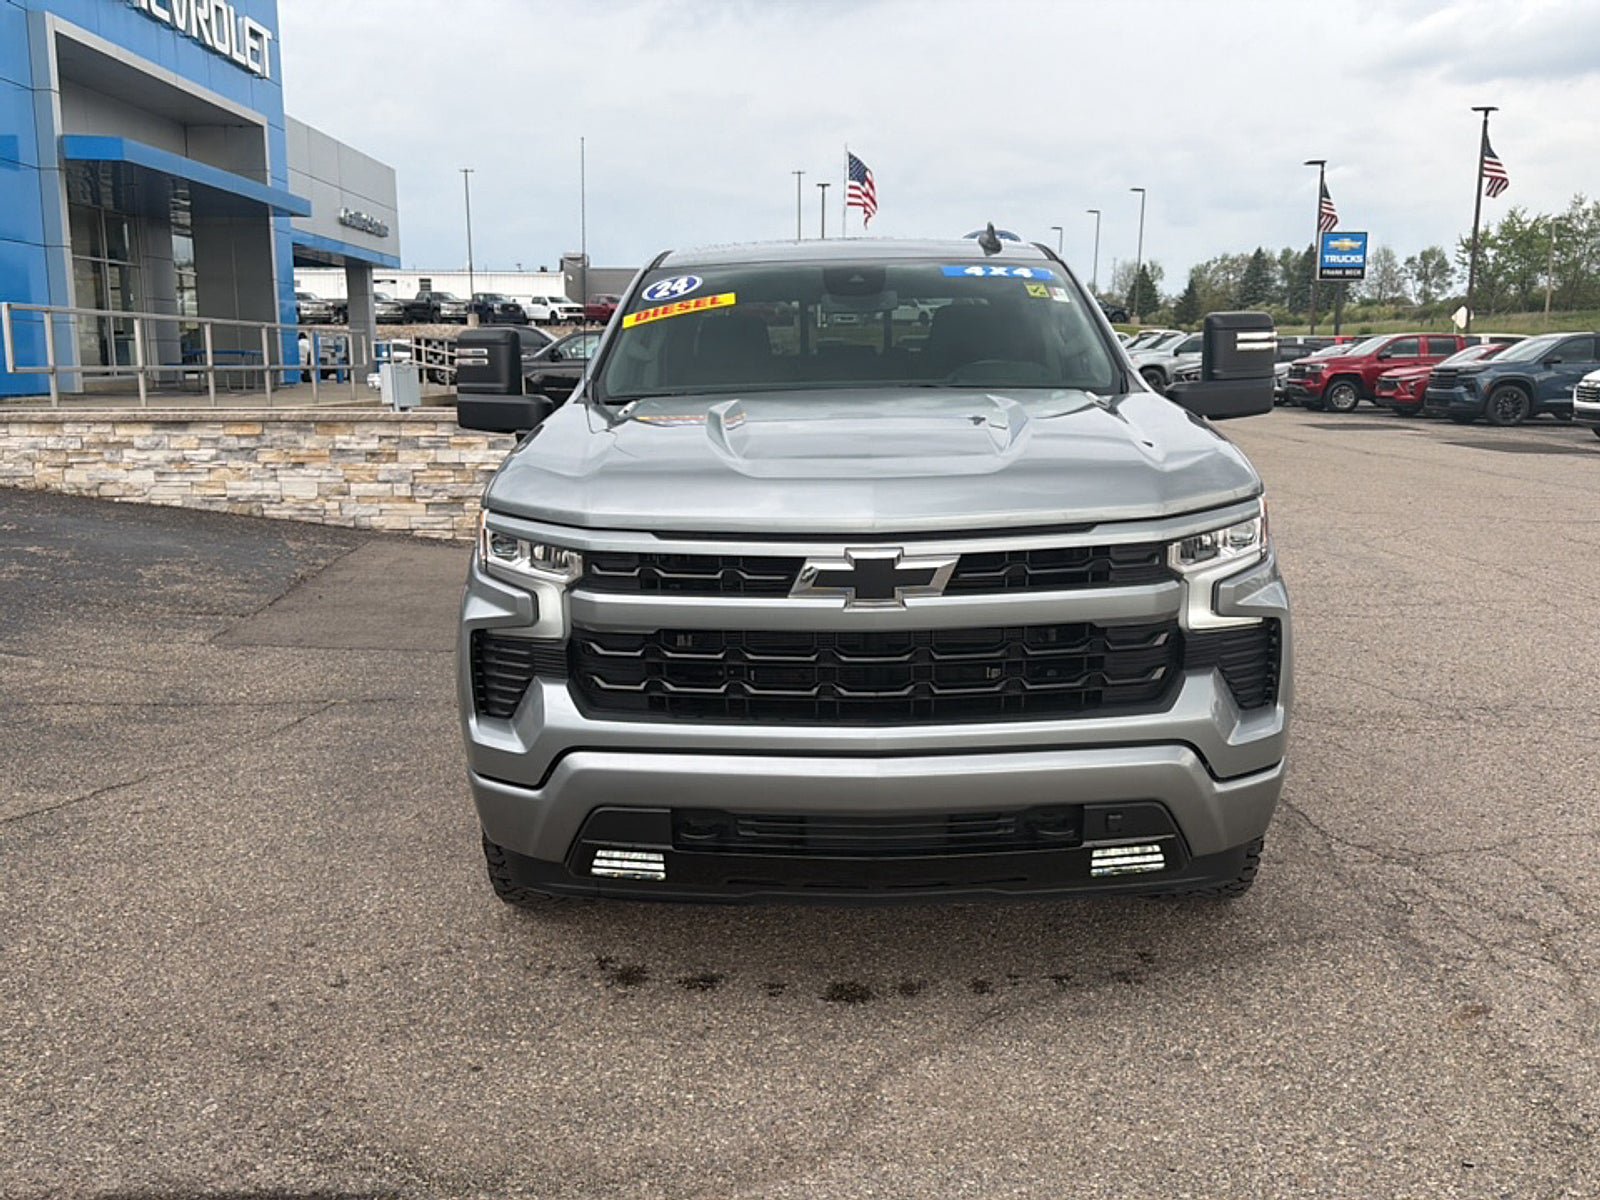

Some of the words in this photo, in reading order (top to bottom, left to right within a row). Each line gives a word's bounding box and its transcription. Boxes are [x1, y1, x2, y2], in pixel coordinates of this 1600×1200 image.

[1324, 255, 1364, 263] TRUCKS
[654, 276, 689, 298] 24
[634, 296, 723, 323] DIESEL
